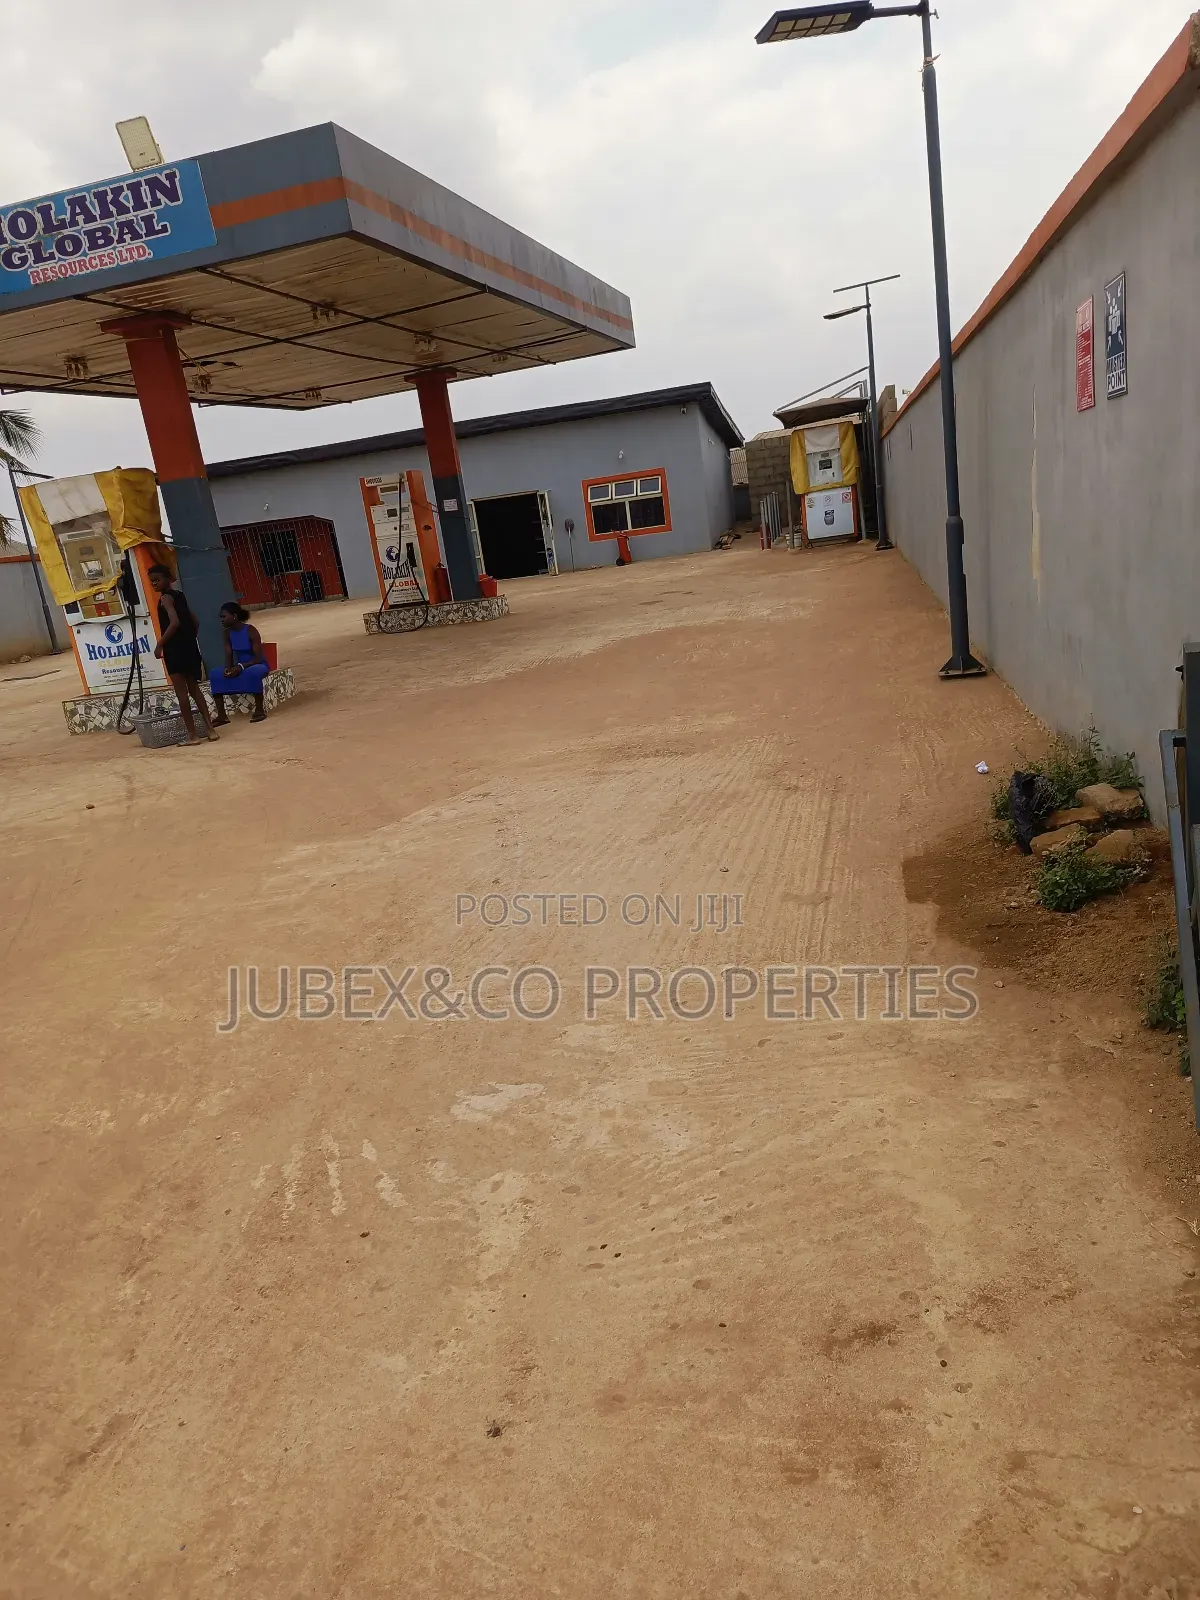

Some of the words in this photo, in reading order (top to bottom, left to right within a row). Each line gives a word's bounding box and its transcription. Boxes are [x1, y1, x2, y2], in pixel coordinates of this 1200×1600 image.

[1, 214, 169, 269] GLOBAL
[30, 250, 116, 285] RESOURCES
[117, 244, 152, 264] LTD.
[1107, 370, 1126, 391] POINT
